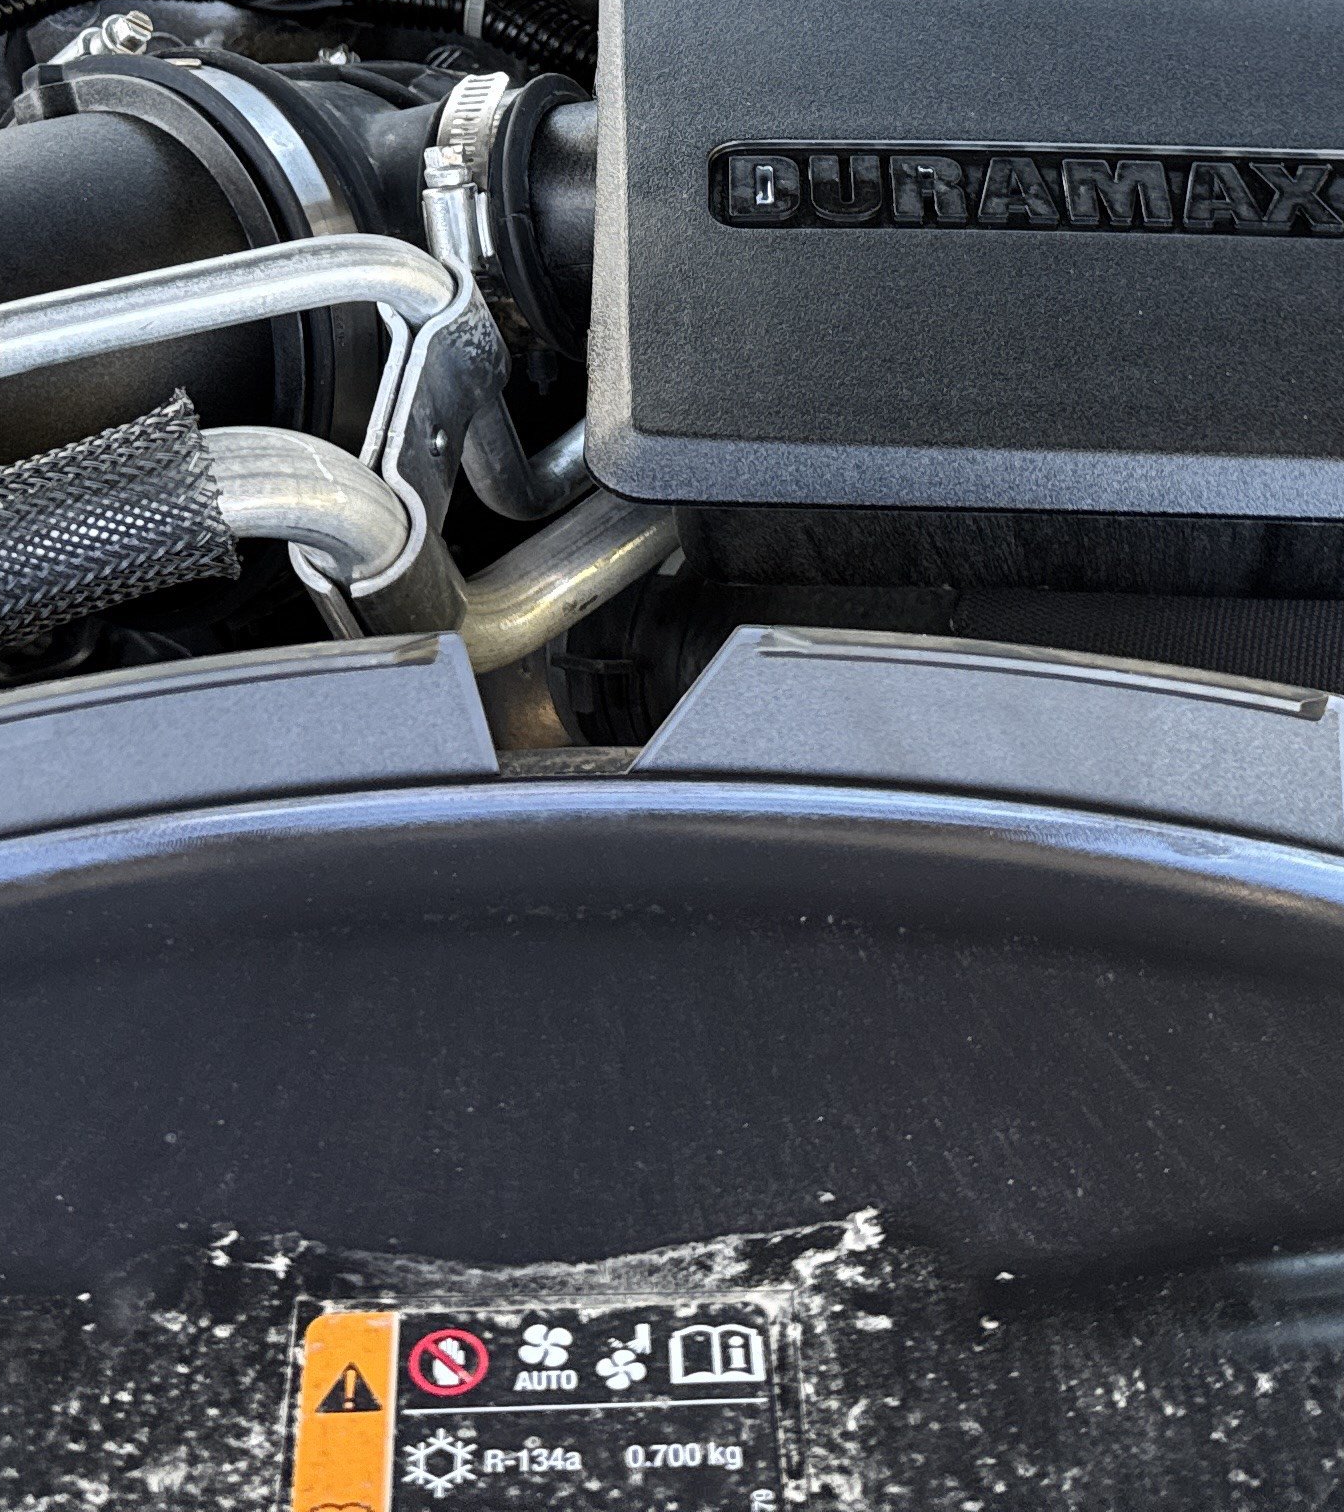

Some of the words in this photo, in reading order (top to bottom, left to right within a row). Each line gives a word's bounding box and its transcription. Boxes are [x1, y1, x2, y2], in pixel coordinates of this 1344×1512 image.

[514, 1369, 577, 1391] AUTO
[485, 1448, 582, 1471] R-134a
[625, 1443, 700, 1468] 0.700
[707, 1441, 743, 1470] kg
